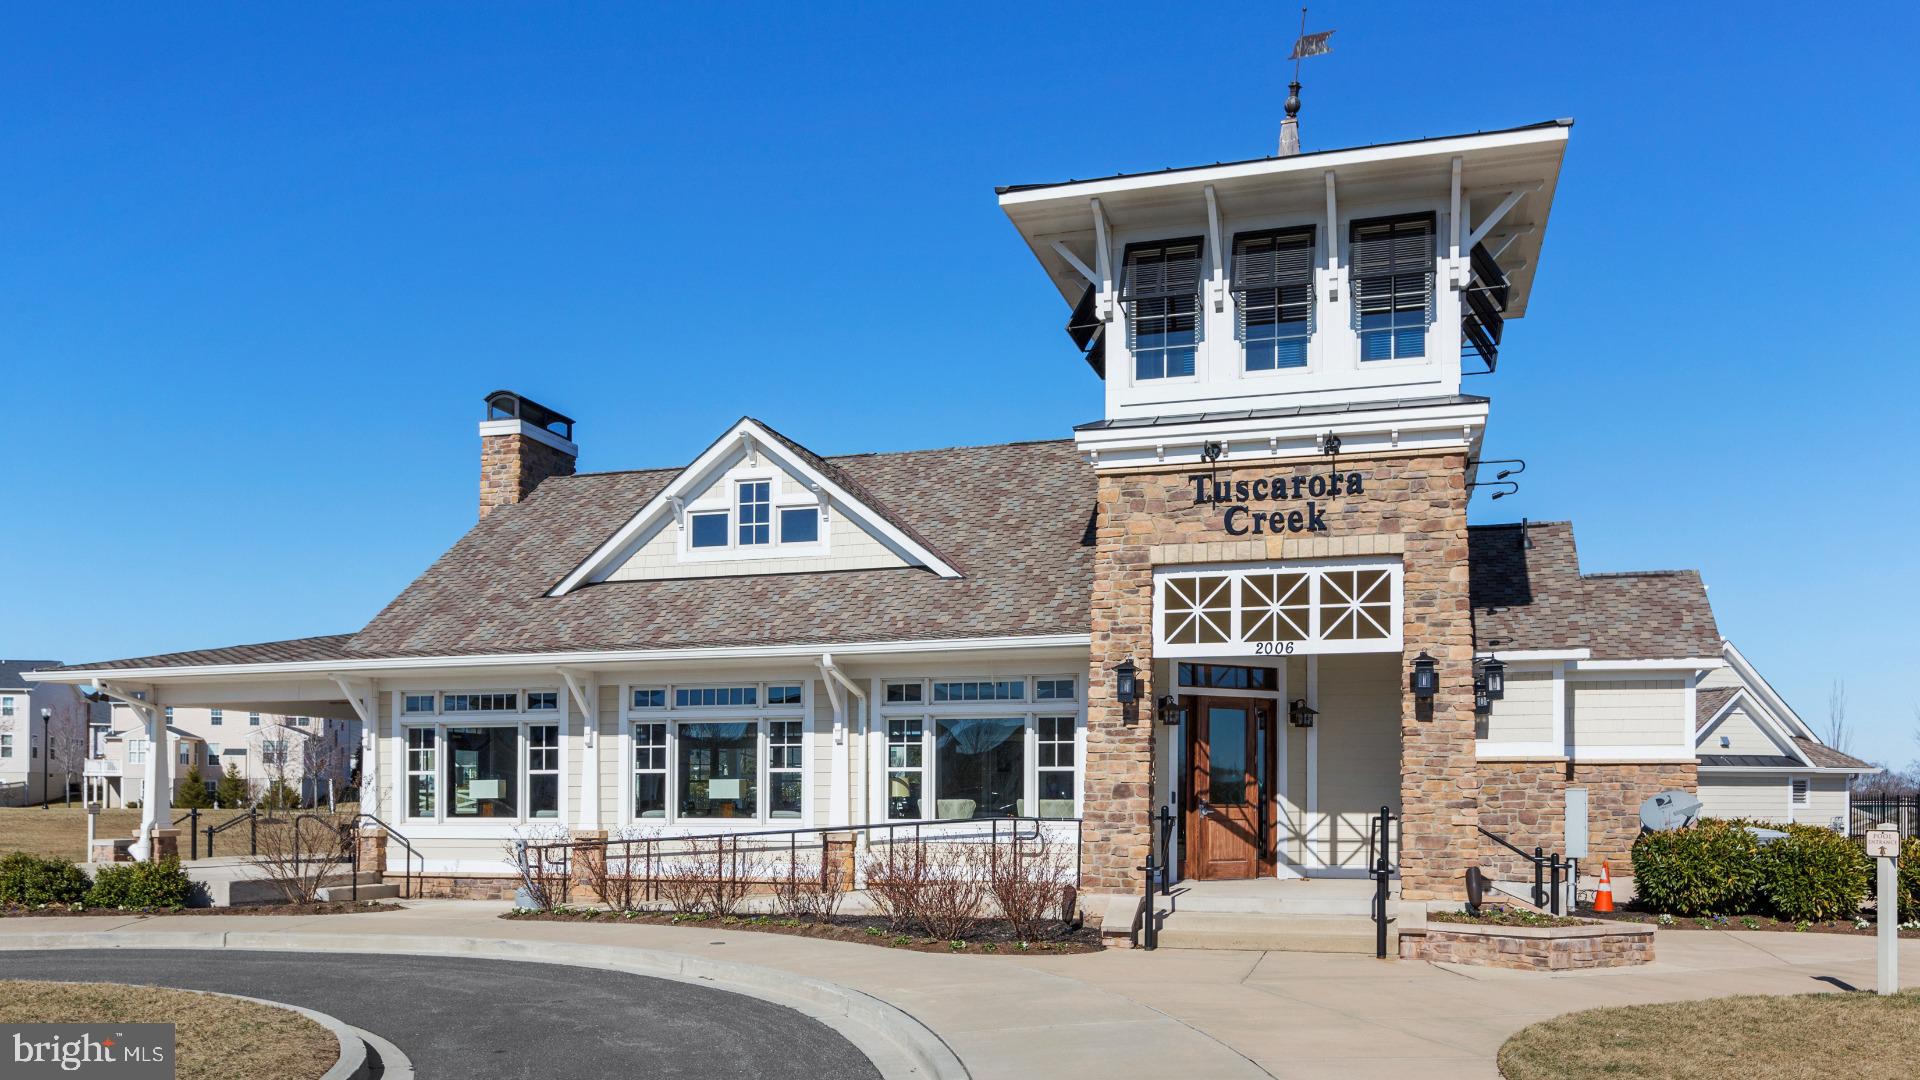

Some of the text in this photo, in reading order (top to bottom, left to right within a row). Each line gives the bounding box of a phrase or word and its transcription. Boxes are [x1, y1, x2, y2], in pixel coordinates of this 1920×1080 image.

[1188, 472, 1364, 505] Tuscarora
[1223, 501, 1327, 536] Creek
[1255, 641, 1294, 655] 2006
